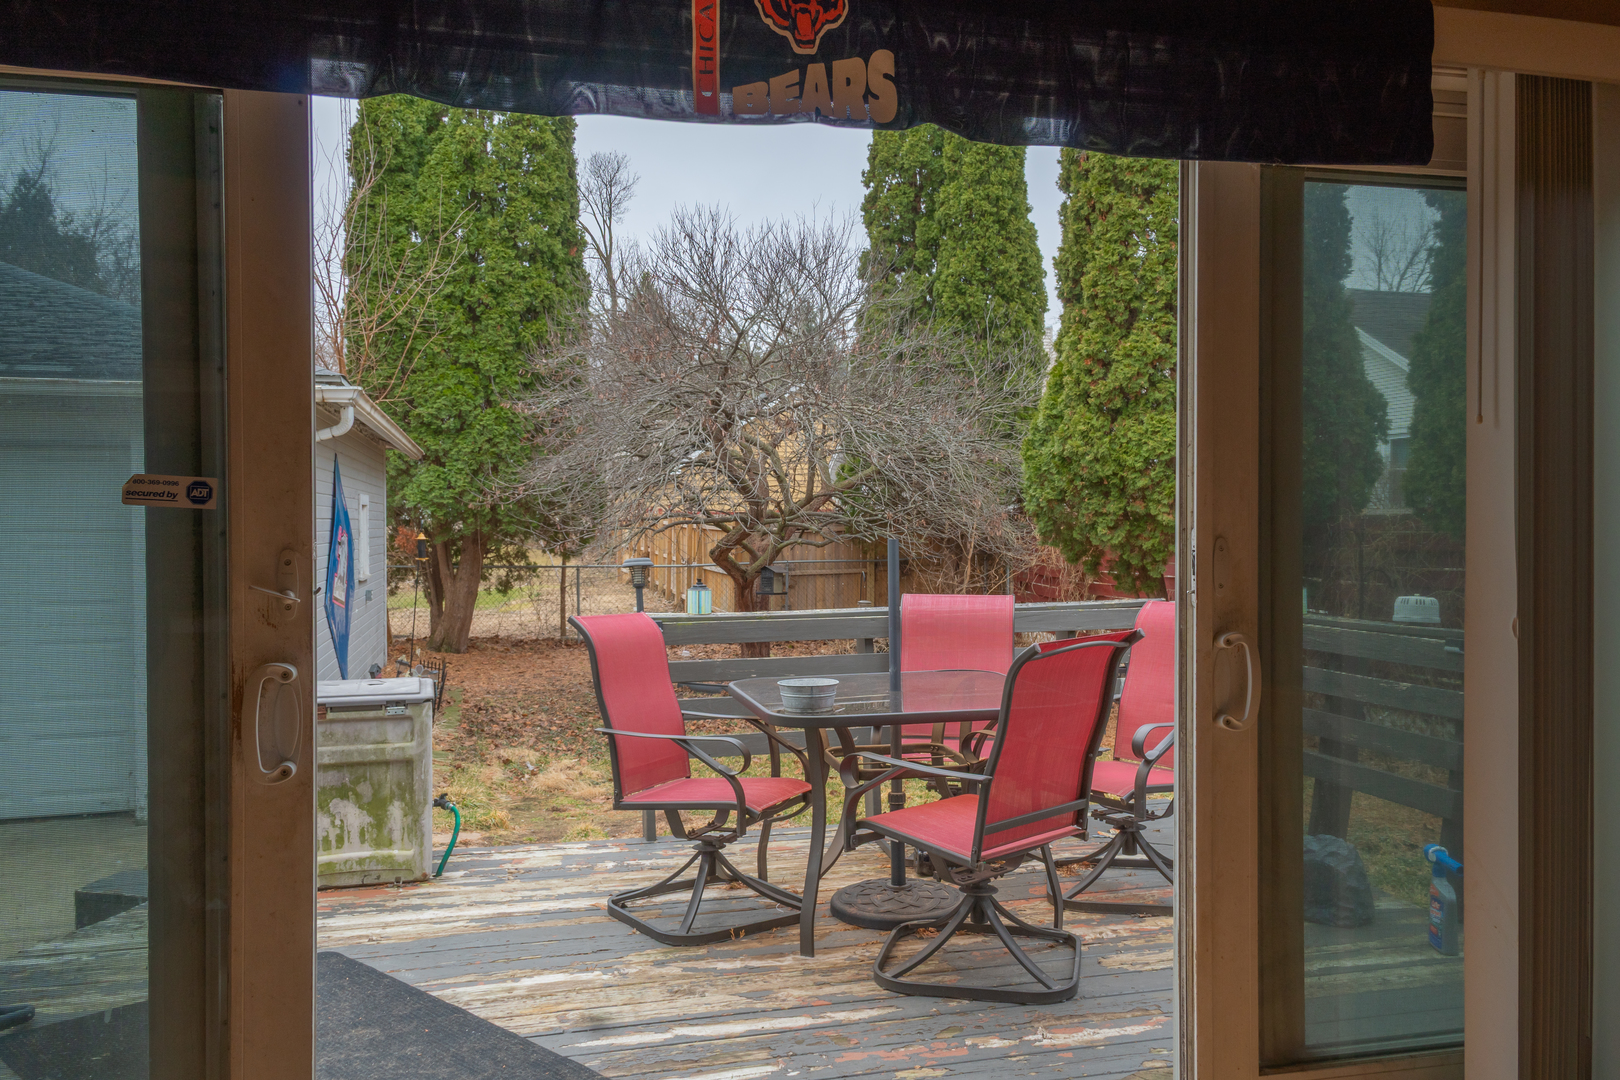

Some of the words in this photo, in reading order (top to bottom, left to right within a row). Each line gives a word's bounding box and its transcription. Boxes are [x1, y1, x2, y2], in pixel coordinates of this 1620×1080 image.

[732, 49, 898, 123] BEARS
[125, 490, 165, 498] secured
[166, 491, 178, 499] by
[190, 489, 209, 497] ADT
